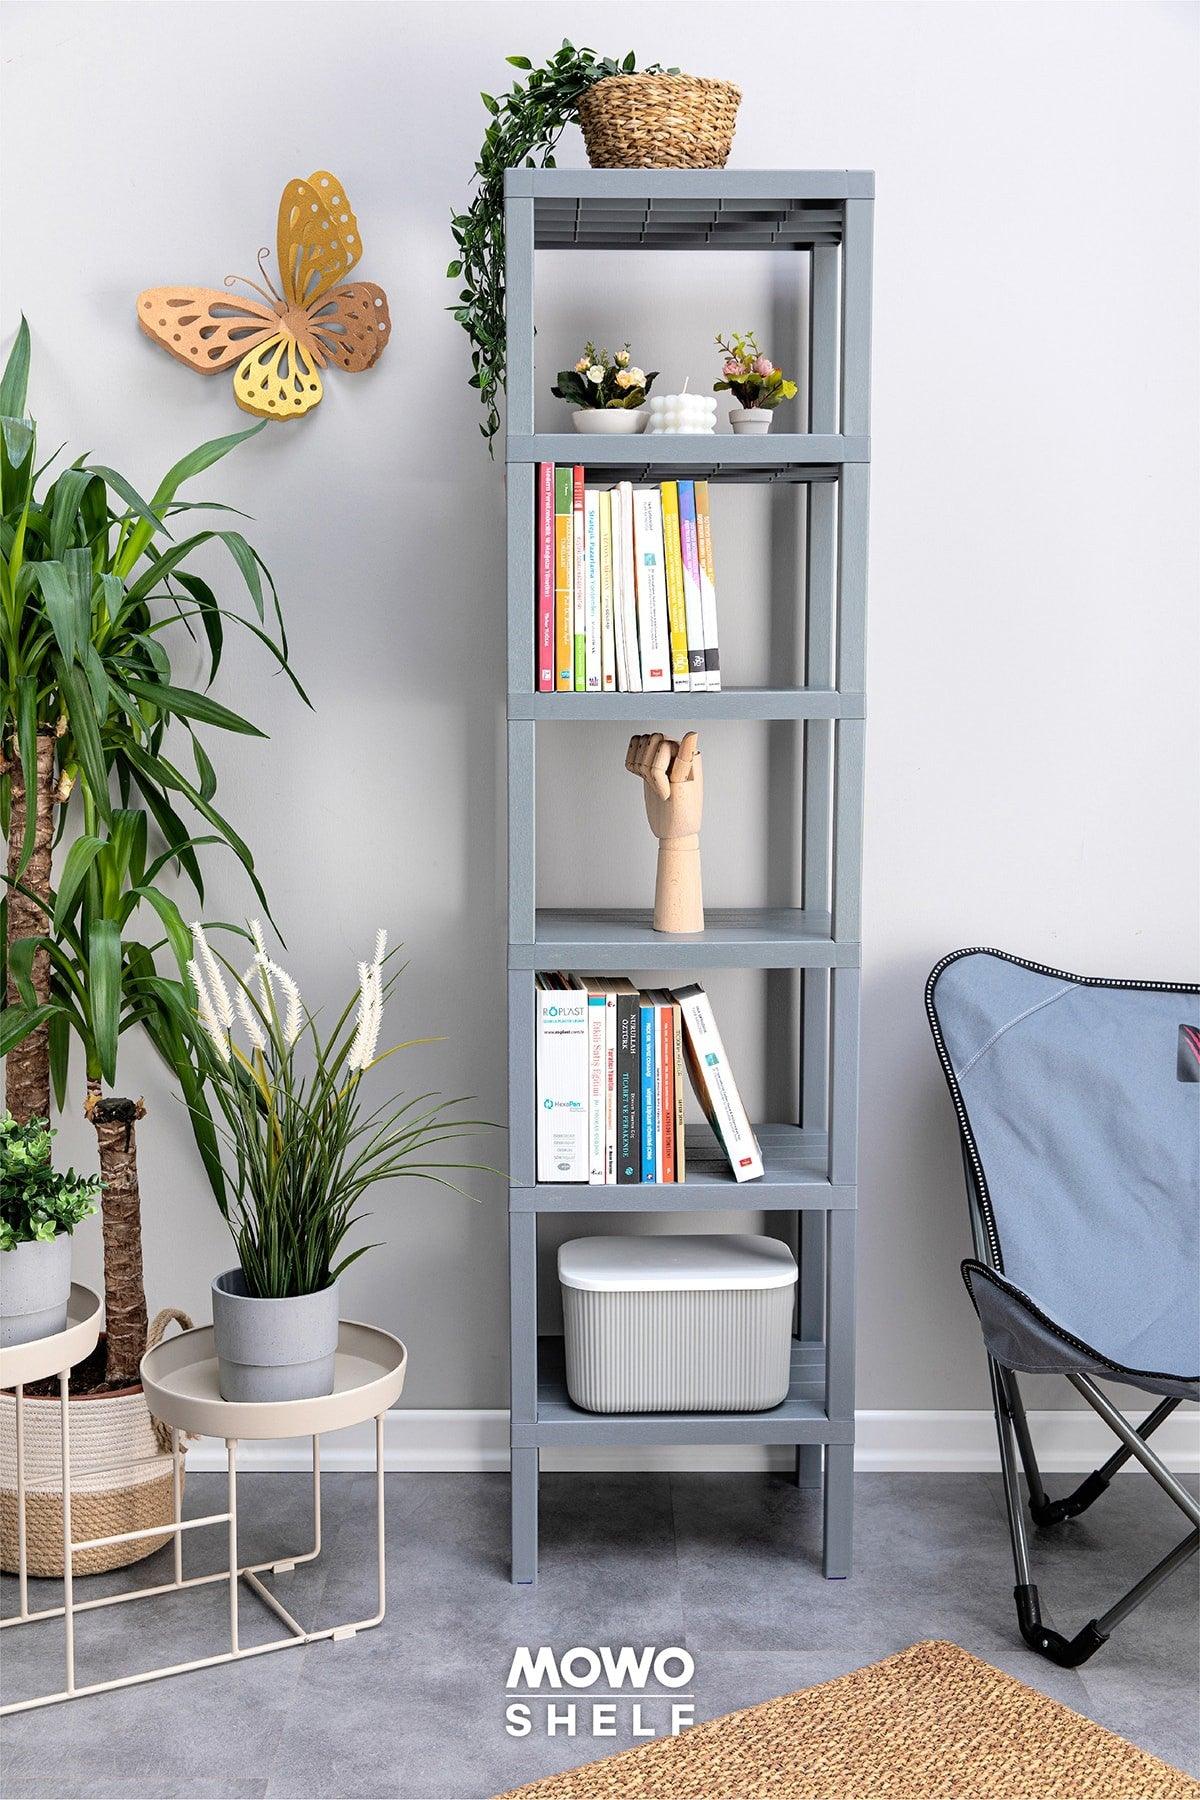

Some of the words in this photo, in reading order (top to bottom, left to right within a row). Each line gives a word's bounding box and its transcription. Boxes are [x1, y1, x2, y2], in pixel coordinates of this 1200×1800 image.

[593, 1021, 602, 1042] Etkili
[591, 1044, 602, 1067] Satış
[622, 1072, 630, 1102] TİCARET
[622, 1104, 630, 1114] VE
[622, 1115, 630, 1158] PERAKENDE
